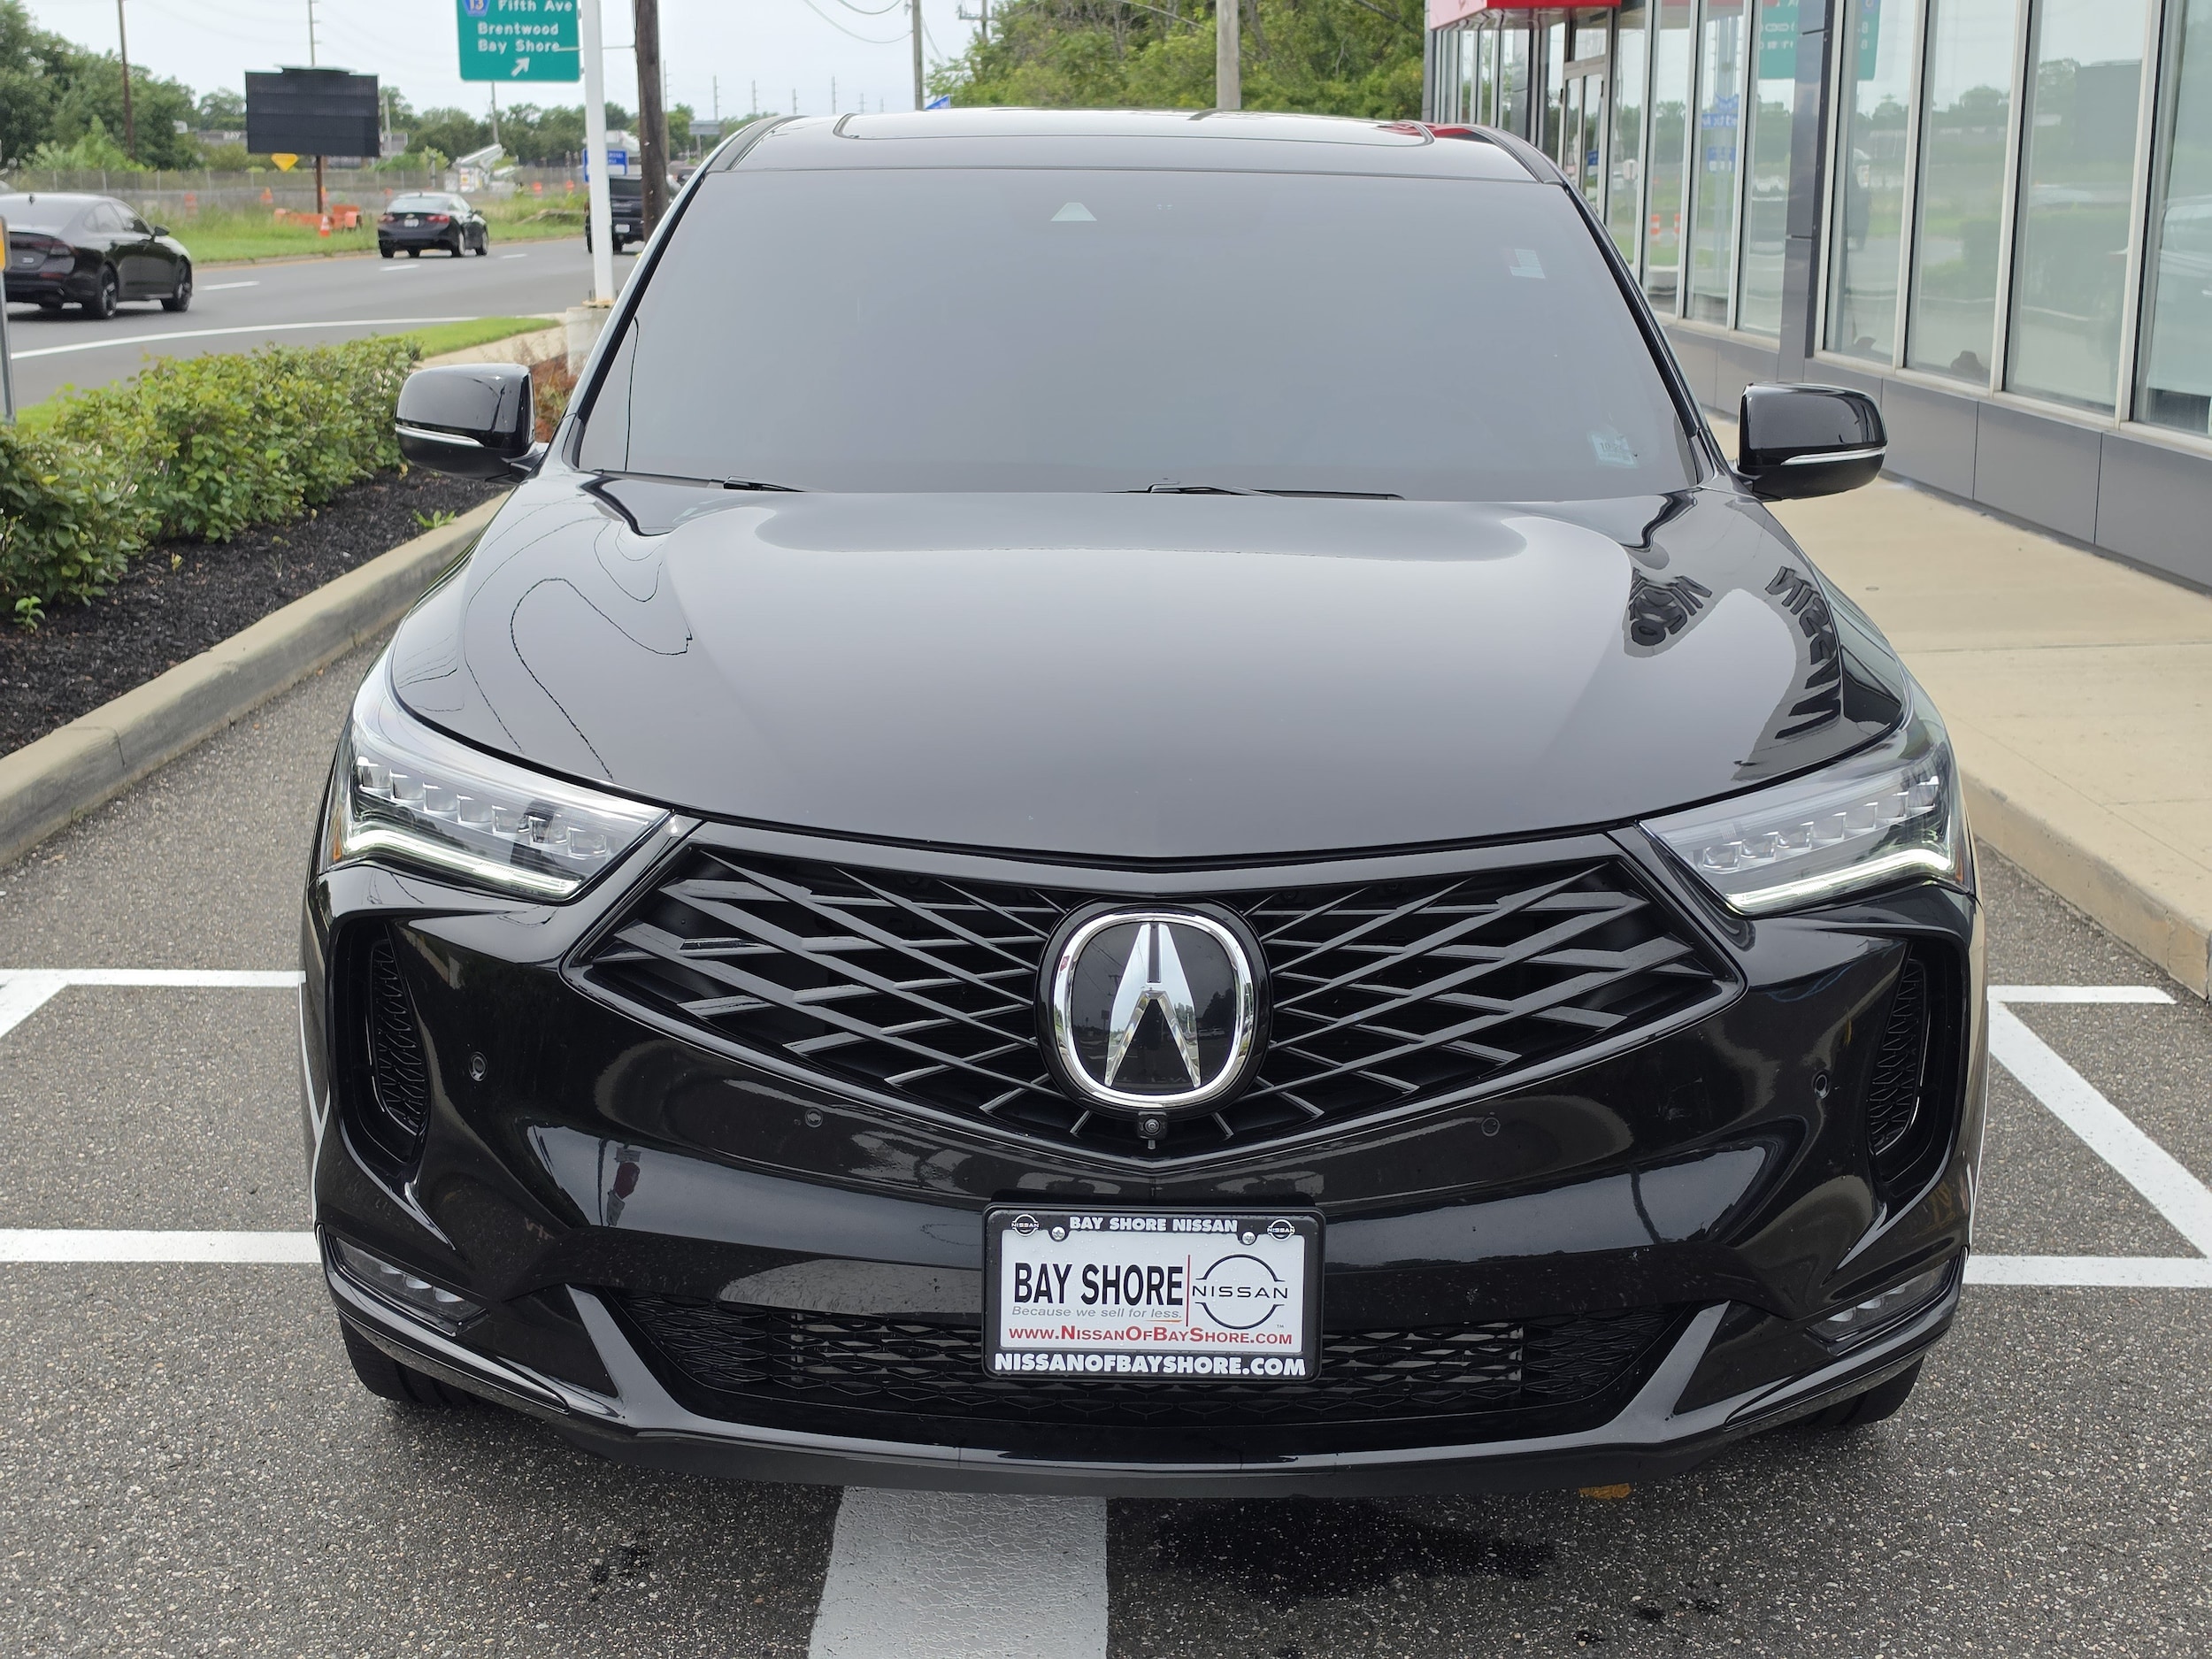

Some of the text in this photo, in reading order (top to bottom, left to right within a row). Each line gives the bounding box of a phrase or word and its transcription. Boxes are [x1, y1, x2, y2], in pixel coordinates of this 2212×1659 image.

[497, 0, 573, 12] Fifth Ave
[477, 21, 559, 35] Brentwood
[477, 39, 560, 55] Bay Shore
[1069, 1217, 1238, 1233] BAY SHORE NISSAN
[1014, 1262, 1183, 1306] BAY SHORE
[1192, 1285, 1288, 1299] NISSAN
[1011, 1305, 1182, 1318] Because we sell for less.
[995, 1353, 1306, 1376] NISSANOFBAYSHORE.COM
